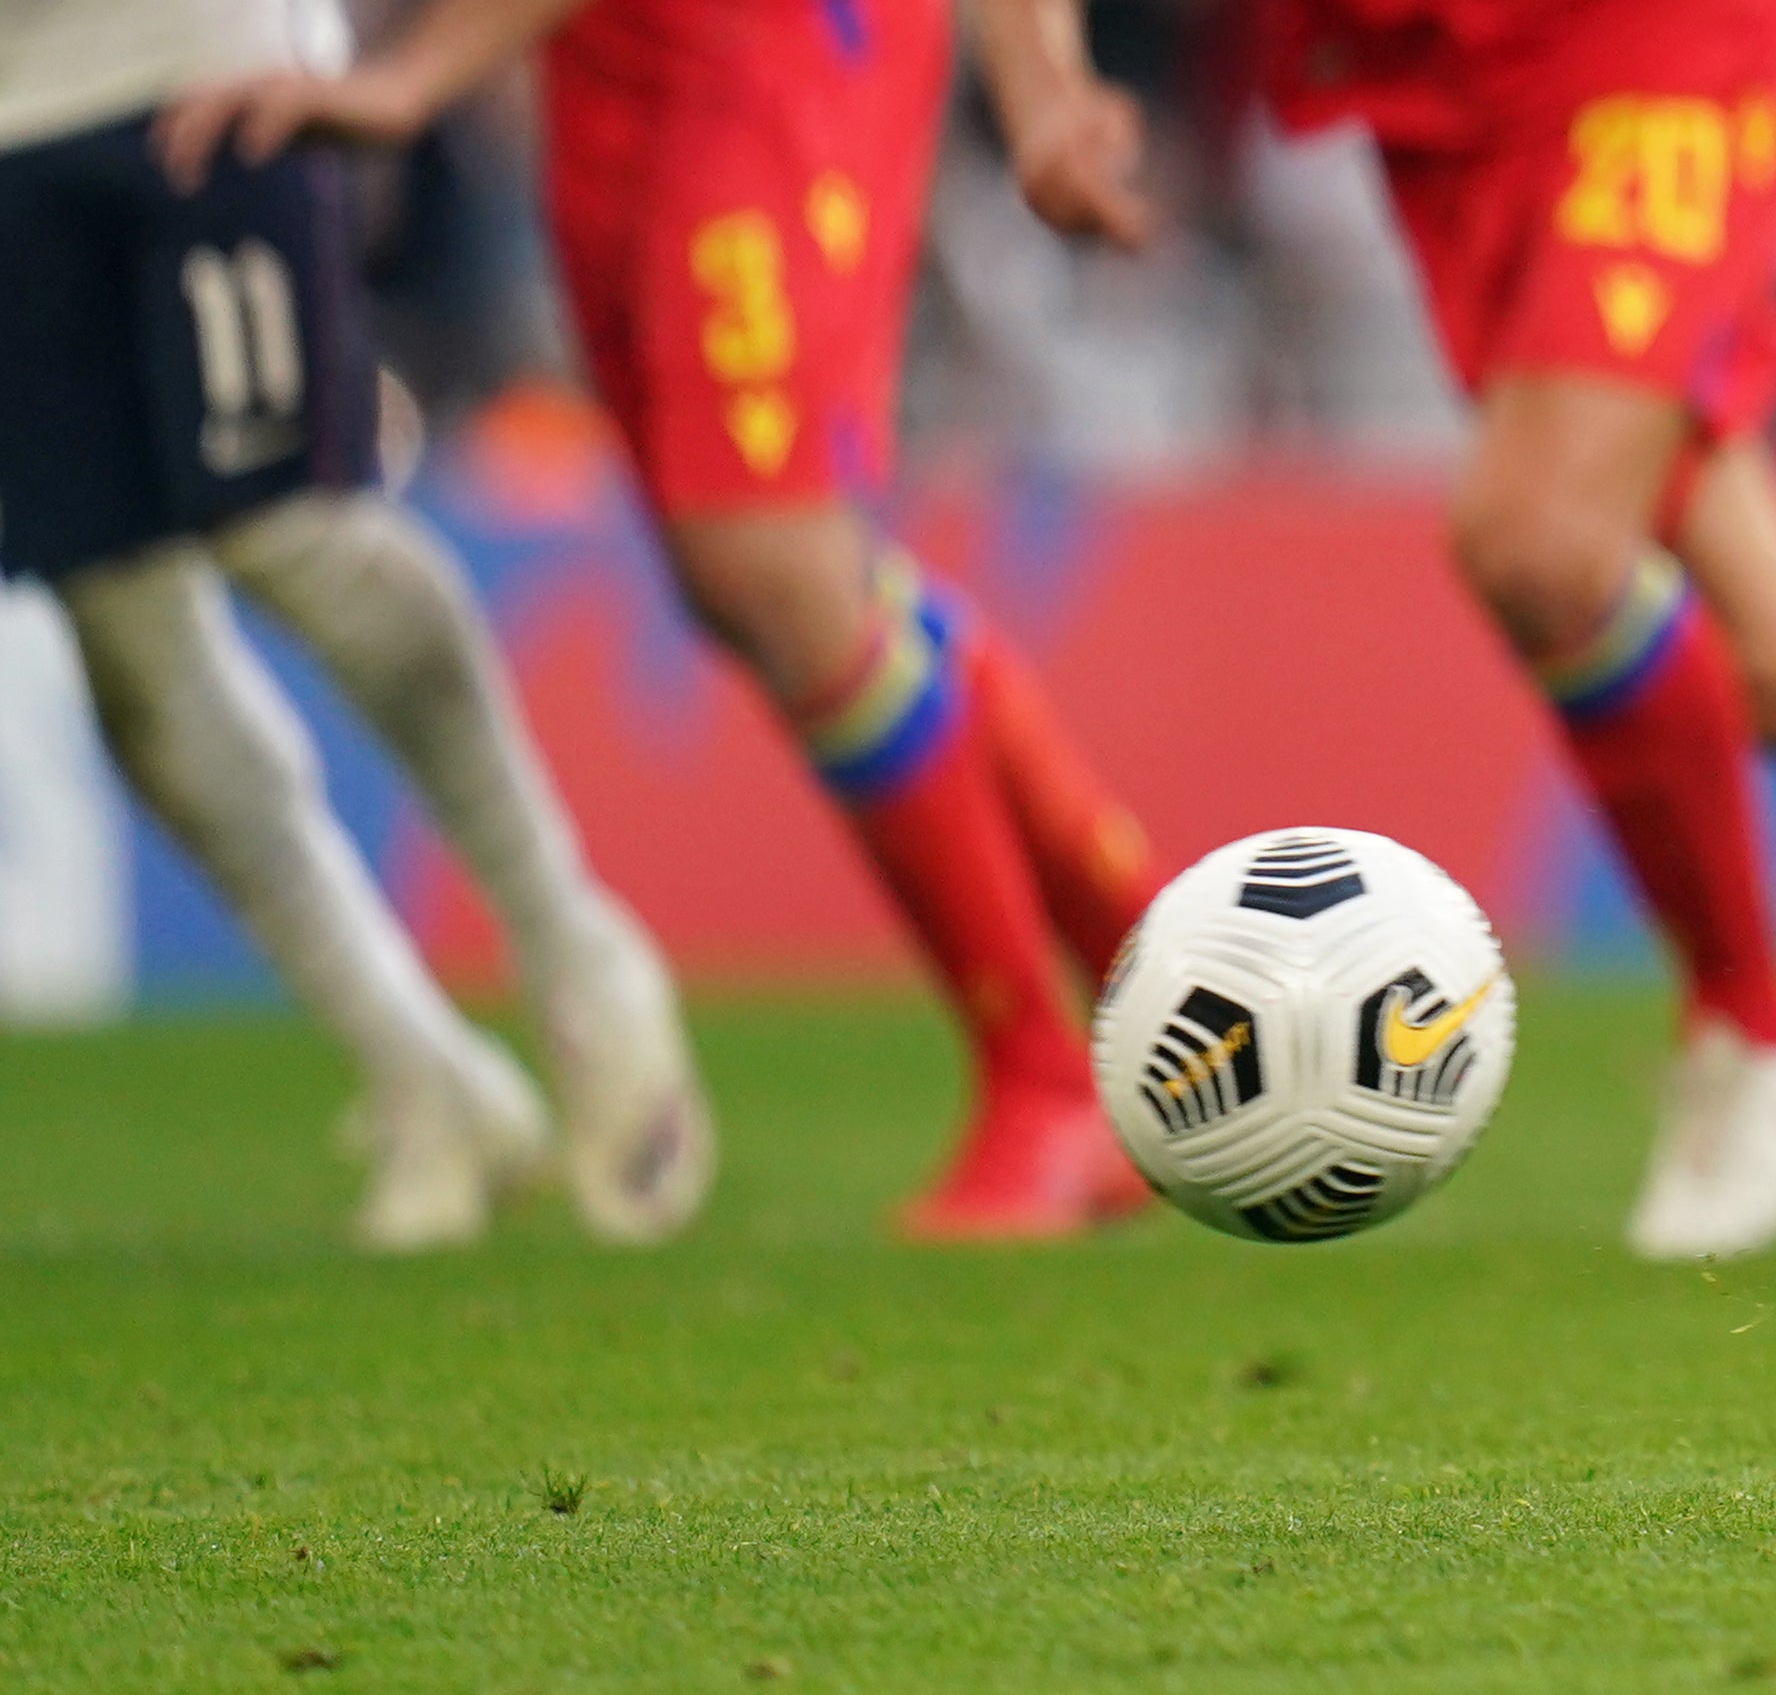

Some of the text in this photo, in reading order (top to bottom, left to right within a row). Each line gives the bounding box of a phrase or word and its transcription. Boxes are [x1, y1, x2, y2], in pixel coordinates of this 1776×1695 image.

[1558, 94, 1730, 263] 20
[183, 234, 305, 417] 11
[690, 210, 798, 403] 3
